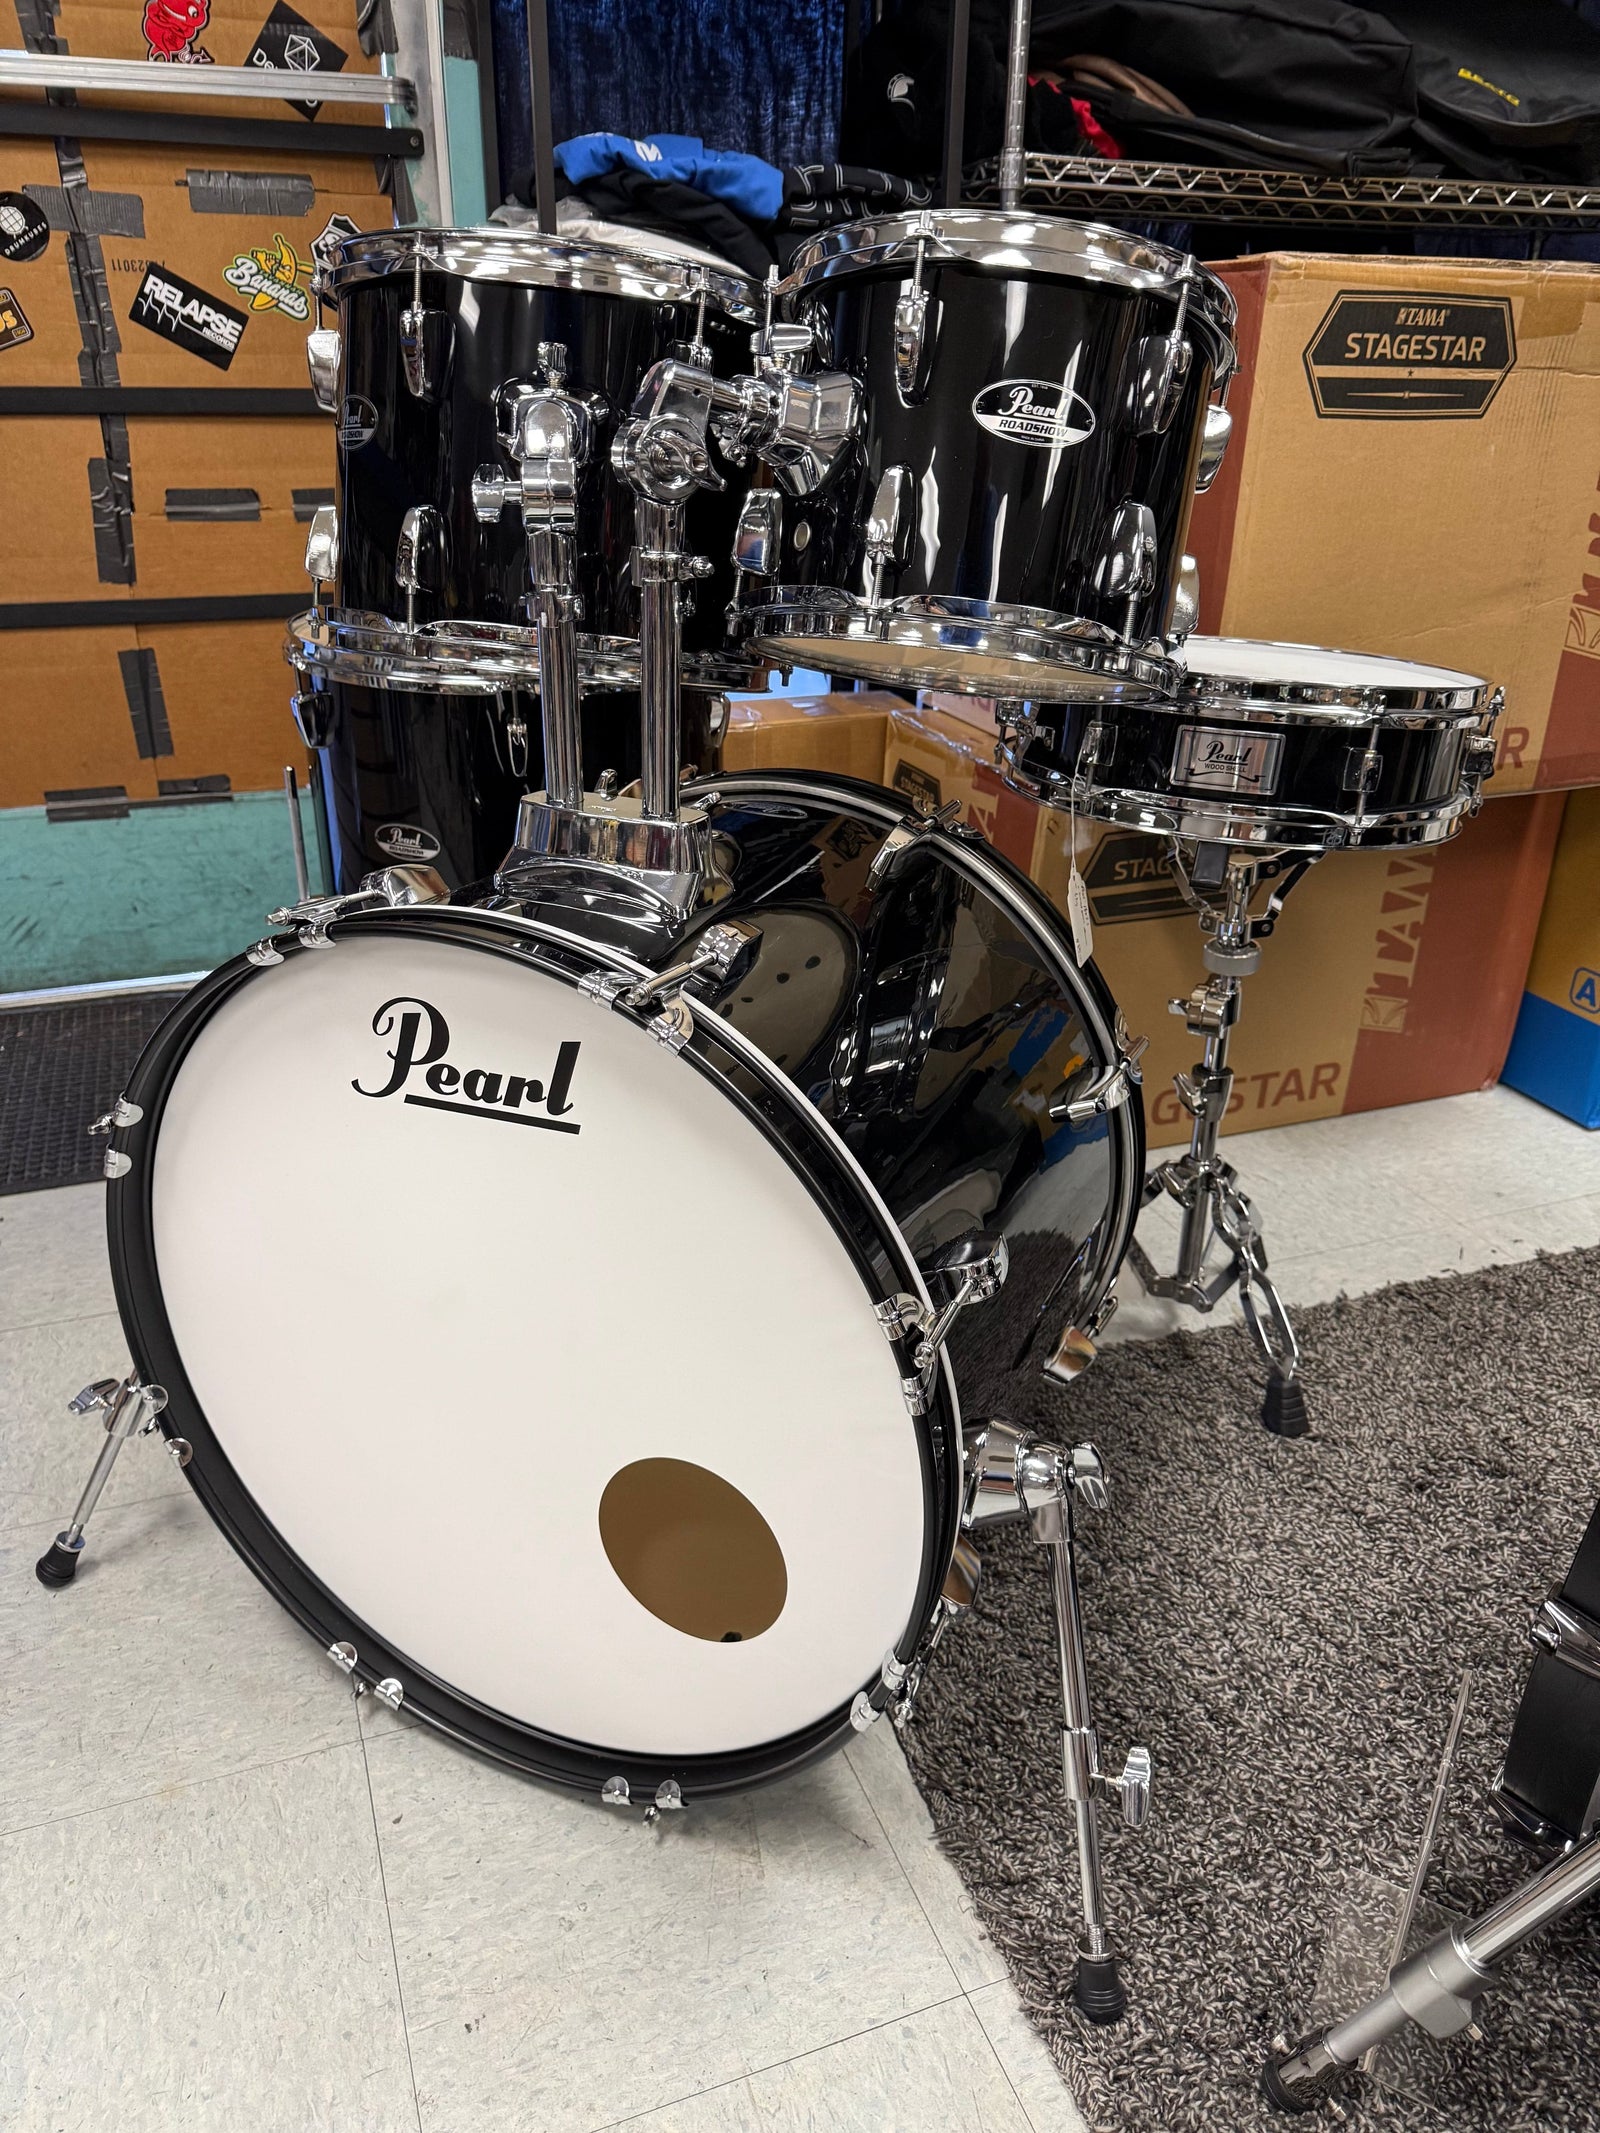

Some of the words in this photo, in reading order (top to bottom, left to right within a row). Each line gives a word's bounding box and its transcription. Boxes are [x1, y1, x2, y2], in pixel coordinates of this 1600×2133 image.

[225, 257, 309, 318] Bananas
[143, 273, 242, 343] RELAPSE
[1402, 308, 1445, 326] TAMA
[203, 327, 236, 352] RECORDS
[1345, 333, 1486, 362] STAGESTAR
[998, 386, 1067, 419] Pearl
[999, 419, 1067, 438] ROADSHOW
[1198, 741, 1252, 762] Pearl
[1204, 763, 1225, 771] WOOD
[351, 996, 582, 1117] Pearl
